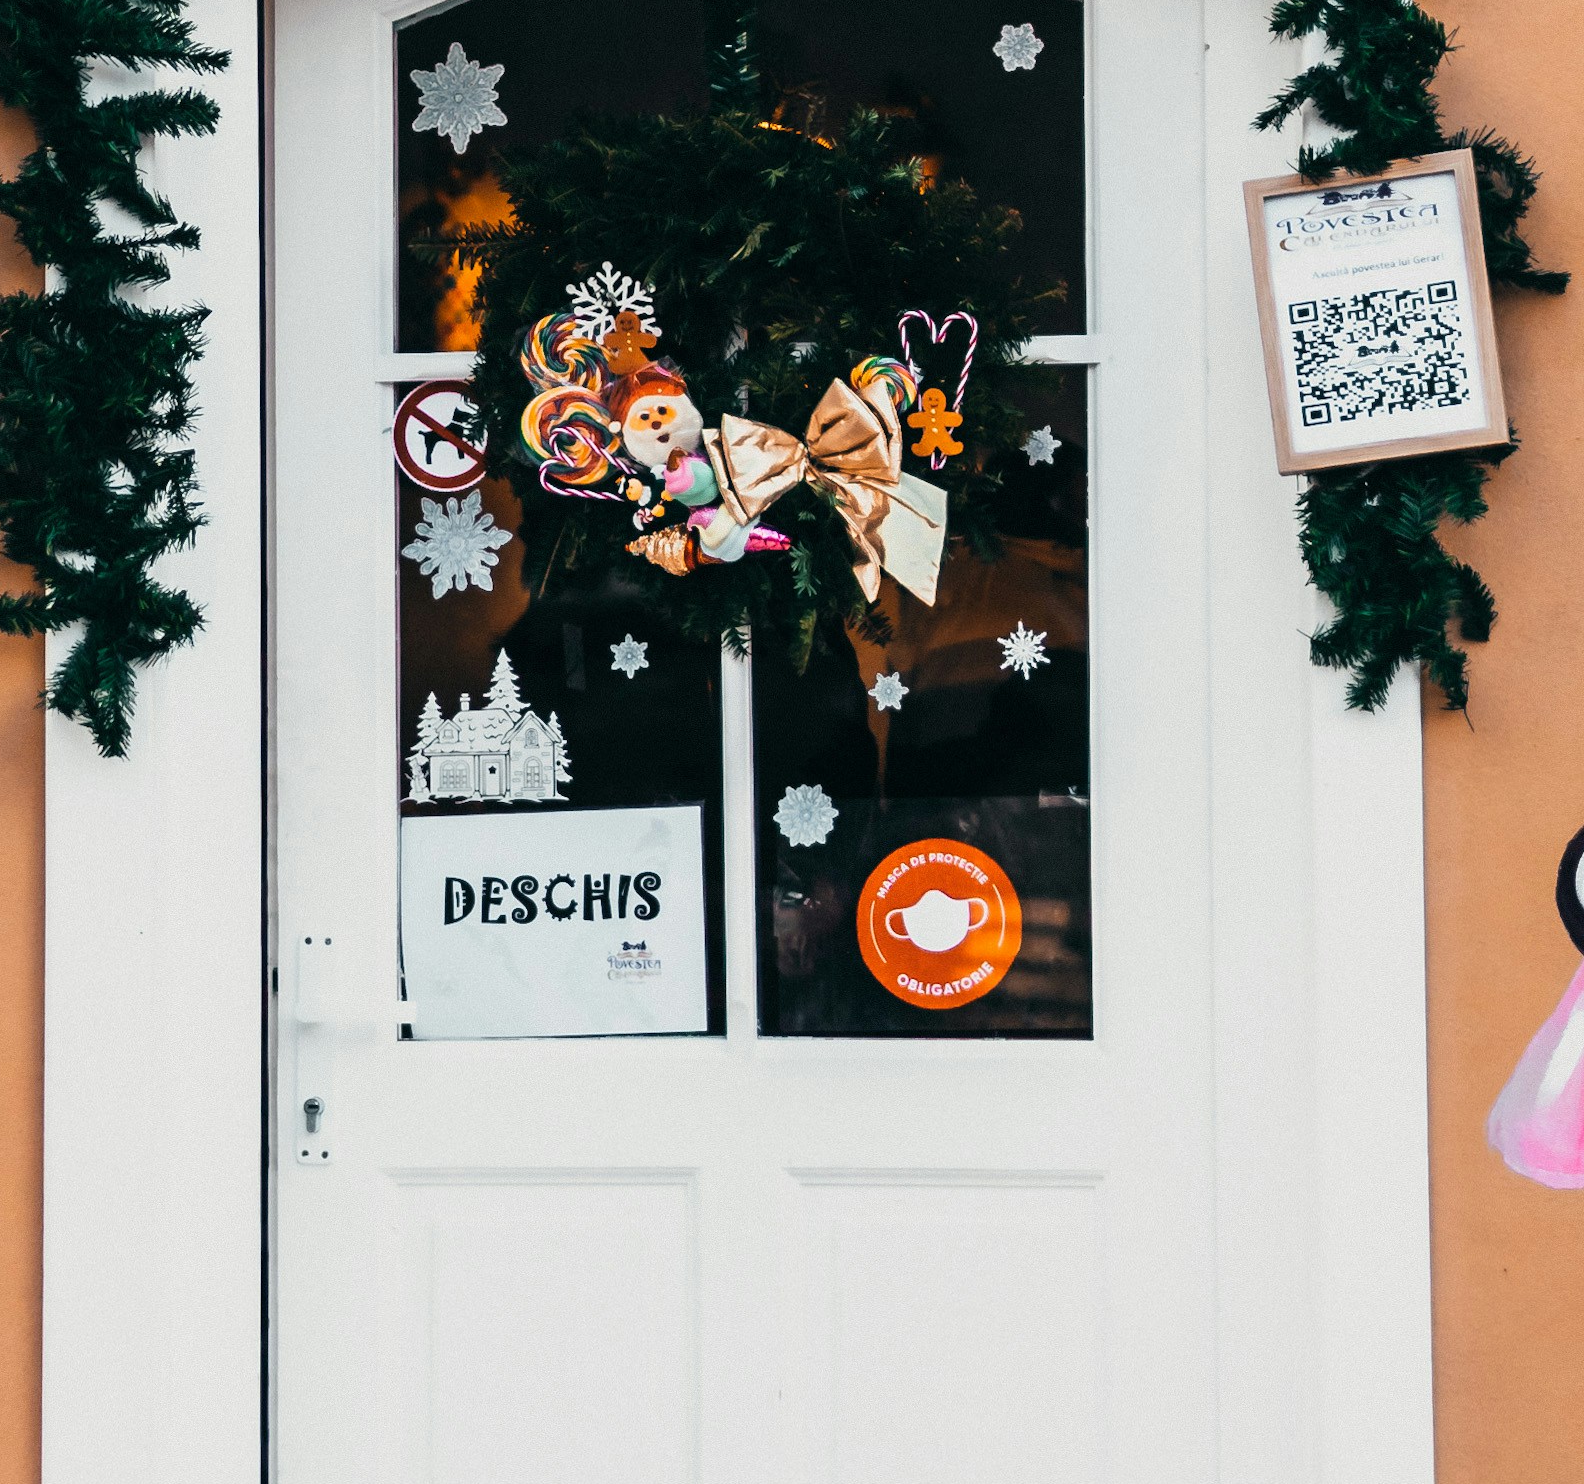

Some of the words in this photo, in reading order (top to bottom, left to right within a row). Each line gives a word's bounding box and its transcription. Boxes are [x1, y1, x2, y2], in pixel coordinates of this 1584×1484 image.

[1276, 204, 1439, 235] POVESTEA
[1352, 261, 1396, 276] povestea
[1398, 258, 1411, 267] lui
[877, 863, 910, 899] MASCA
[909, 854, 927, 867] DE
[444, 871, 662, 925] DESCHIS
[897, 961, 994, 996] OBLIGATORIE
